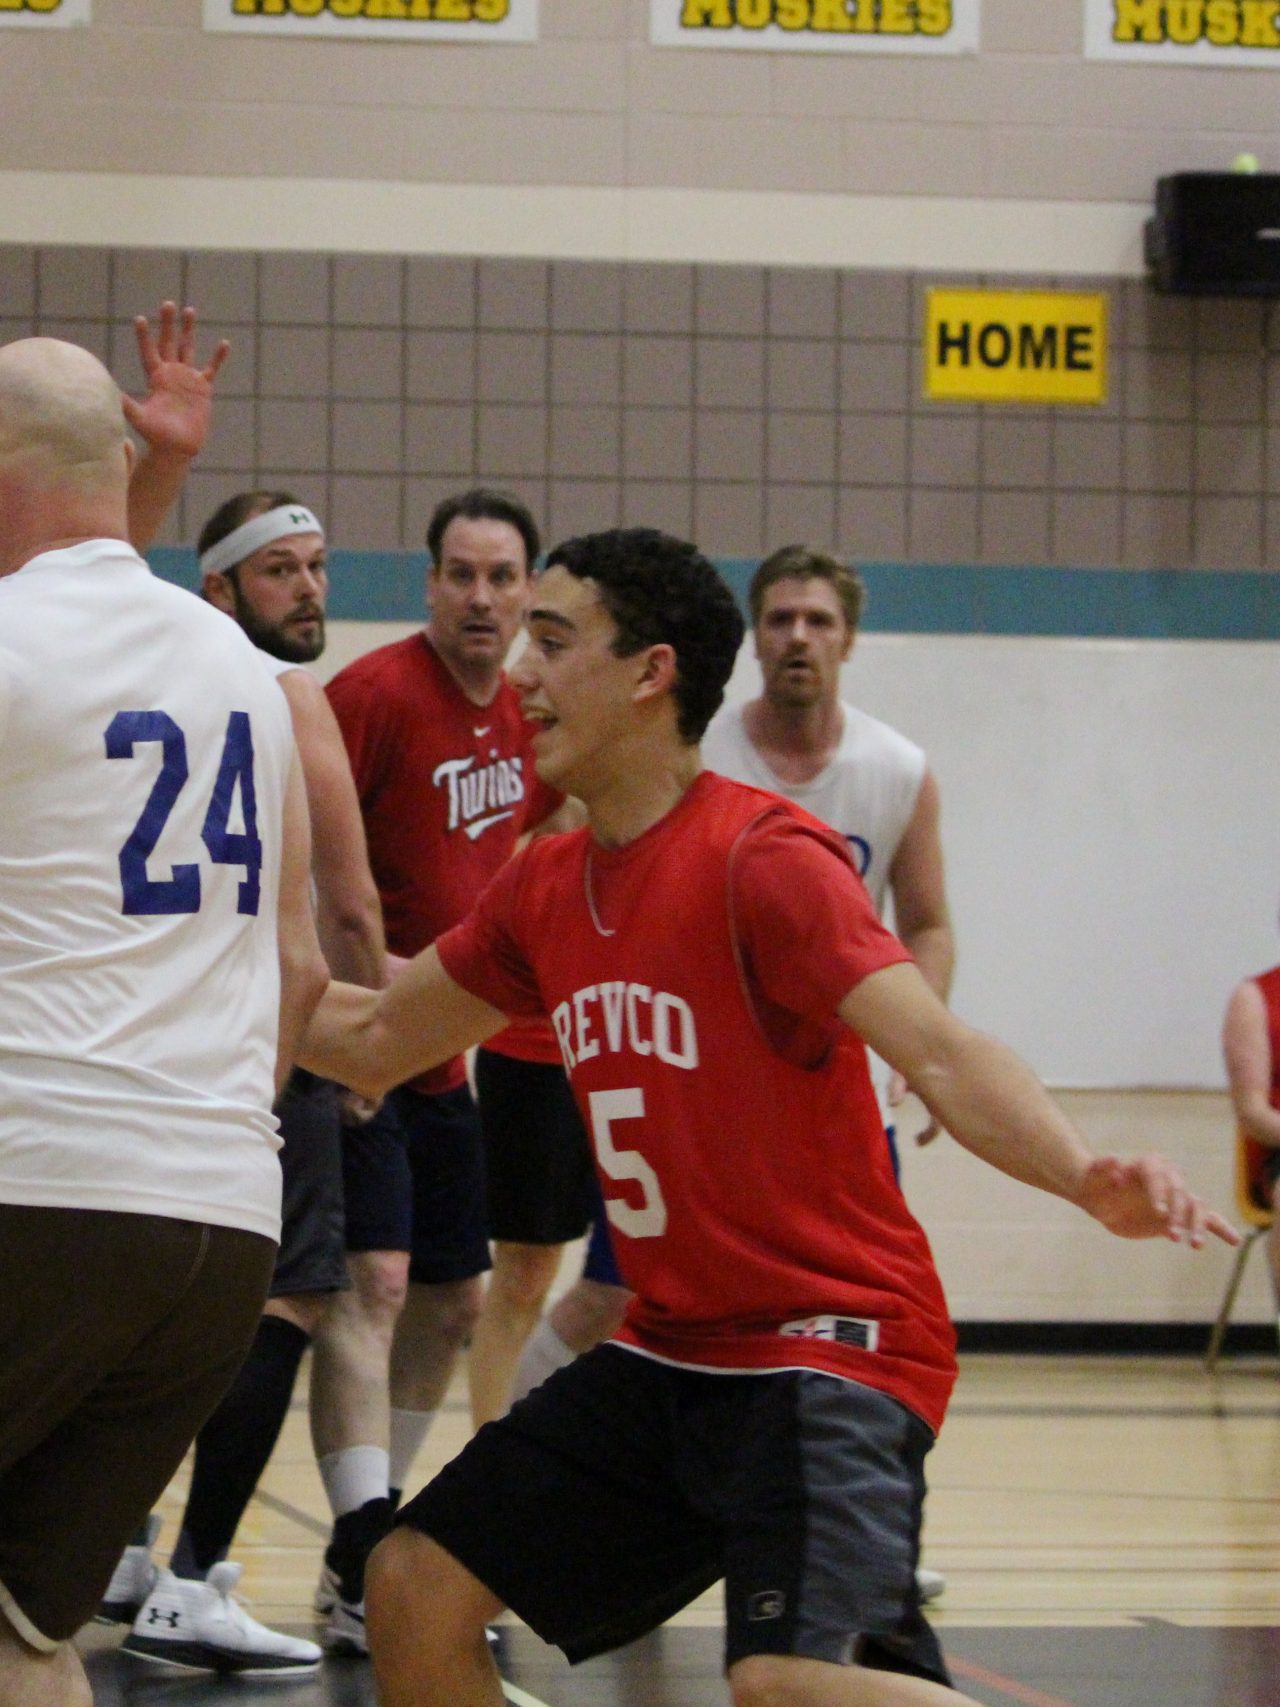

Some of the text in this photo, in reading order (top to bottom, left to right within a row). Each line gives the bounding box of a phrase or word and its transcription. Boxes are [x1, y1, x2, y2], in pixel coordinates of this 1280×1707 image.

[937, 321, 1094, 372] HOME
[104, 710, 262, 916] 24
[432, 747, 525, 838] Twins
[552, 980, 700, 1080] REVCO
[588, 1087, 668, 1239] 5
